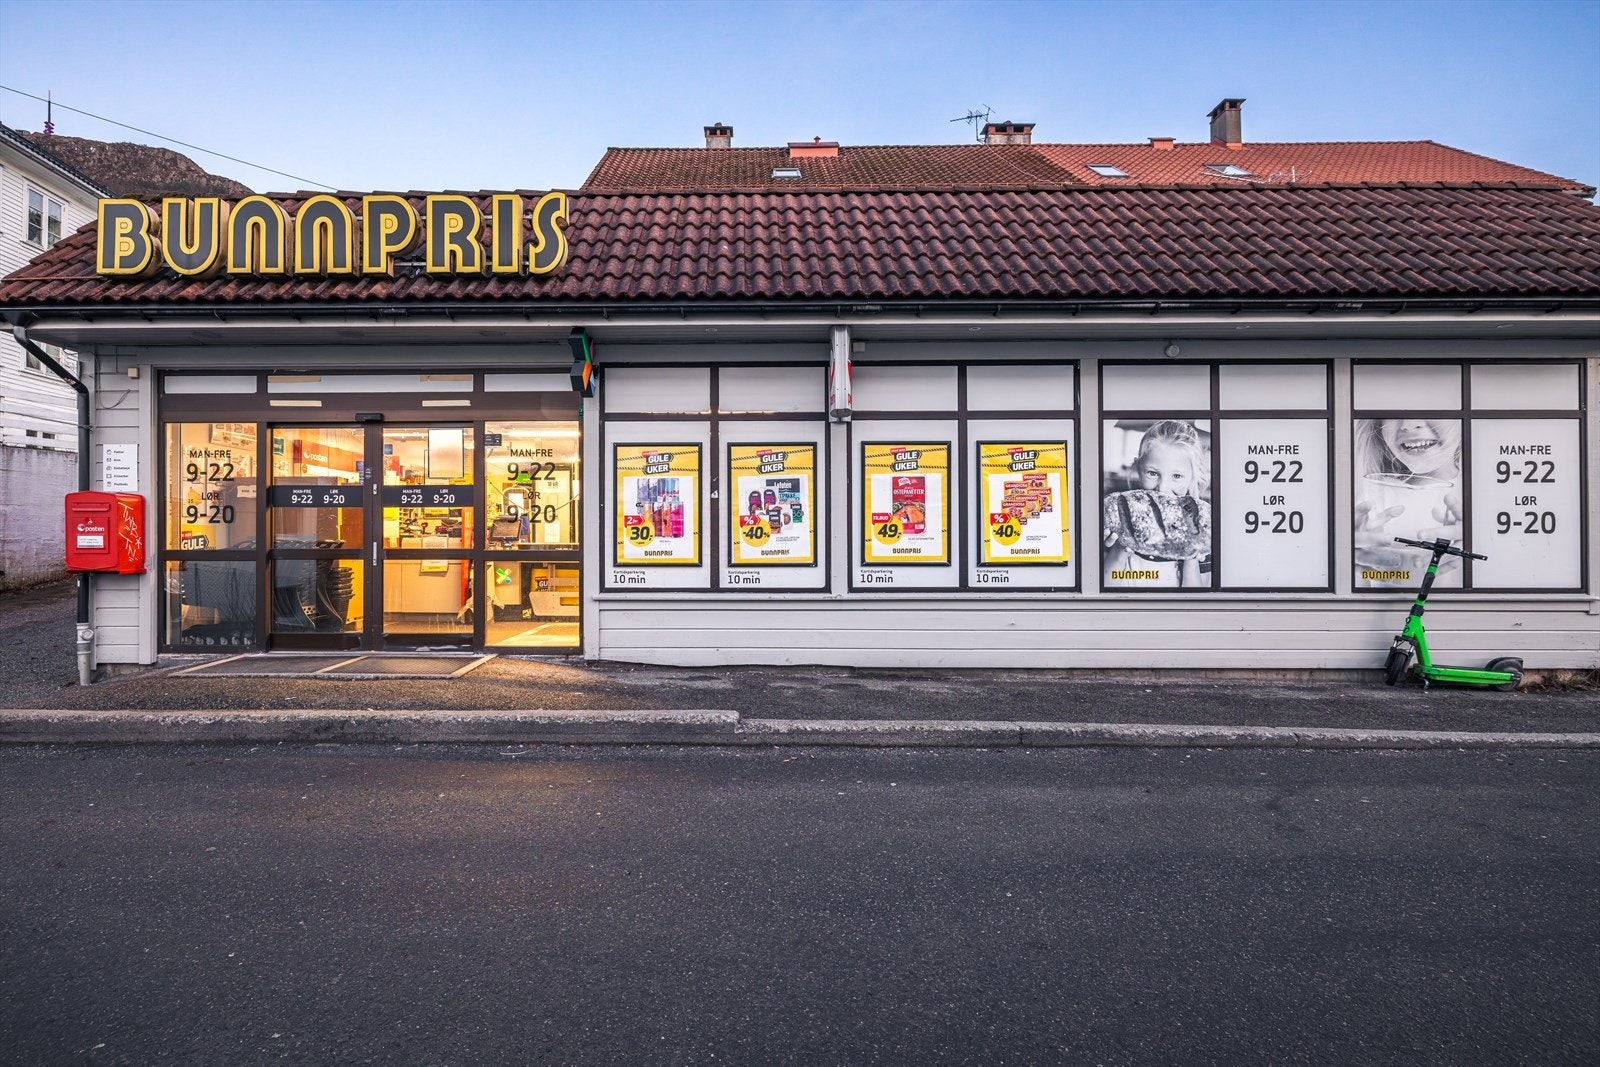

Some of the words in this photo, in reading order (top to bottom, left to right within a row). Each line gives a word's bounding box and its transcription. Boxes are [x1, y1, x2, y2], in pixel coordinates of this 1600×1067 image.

[97, 192, 568, 277] BUNNPRIS
[190, 450, 232, 458] MAN-FRE
[510, 449, 553, 457] MAN-FRE
[1248, 445, 1300, 454] MAN-FRE
[1500, 445, 1552, 455] MAN-FRE
[648, 454, 669, 463] GULE
[762, 453, 783, 462] GULE
[896, 452, 917, 460] GULE
[1014, 452, 1035, 460] GULE
[647, 464, 668, 473] UKER
[762, 464, 783, 472] UKER
[896, 462, 916, 470] UKER
[1013, 462, 1034, 470] UKER
[186, 463, 234, 482] 9-22
[508, 462, 556, 480] 9-22
[1244, 460, 1303, 483] 9-22
[1496, 460, 1555, 484] 9-22
[202, 492, 219, 500] LØR
[292, 495, 313, 504] 9-22
[324, 495, 344, 504] 9-20
[401, 495, 423, 504] 9-22
[433, 495, 455, 504] 9-20
[1263, 496, 1285, 505] LØR
[1515, 496, 1537, 506] LØR
[186, 505, 234, 524] 9-20
[507, 505, 556, 523] 9-20
[1244, 511, 1304, 534] 9-20
[1497, 511, 1556, 534] 9-20
[182, 538, 204, 550] GULE
[861, 574, 873, 583] 10
[876, 575, 893, 583] min
[977, 574, 989, 583] 10
[992, 574, 1009, 582] min
[1111, 570, 1160, 579] BUNNPRIS
[1362, 570, 1410, 580] BUNNPRIS
[614, 575, 626, 584] 10
[628, 575, 646, 583] min
[728, 575, 740, 584] 10
[743, 575, 760, 583] min
